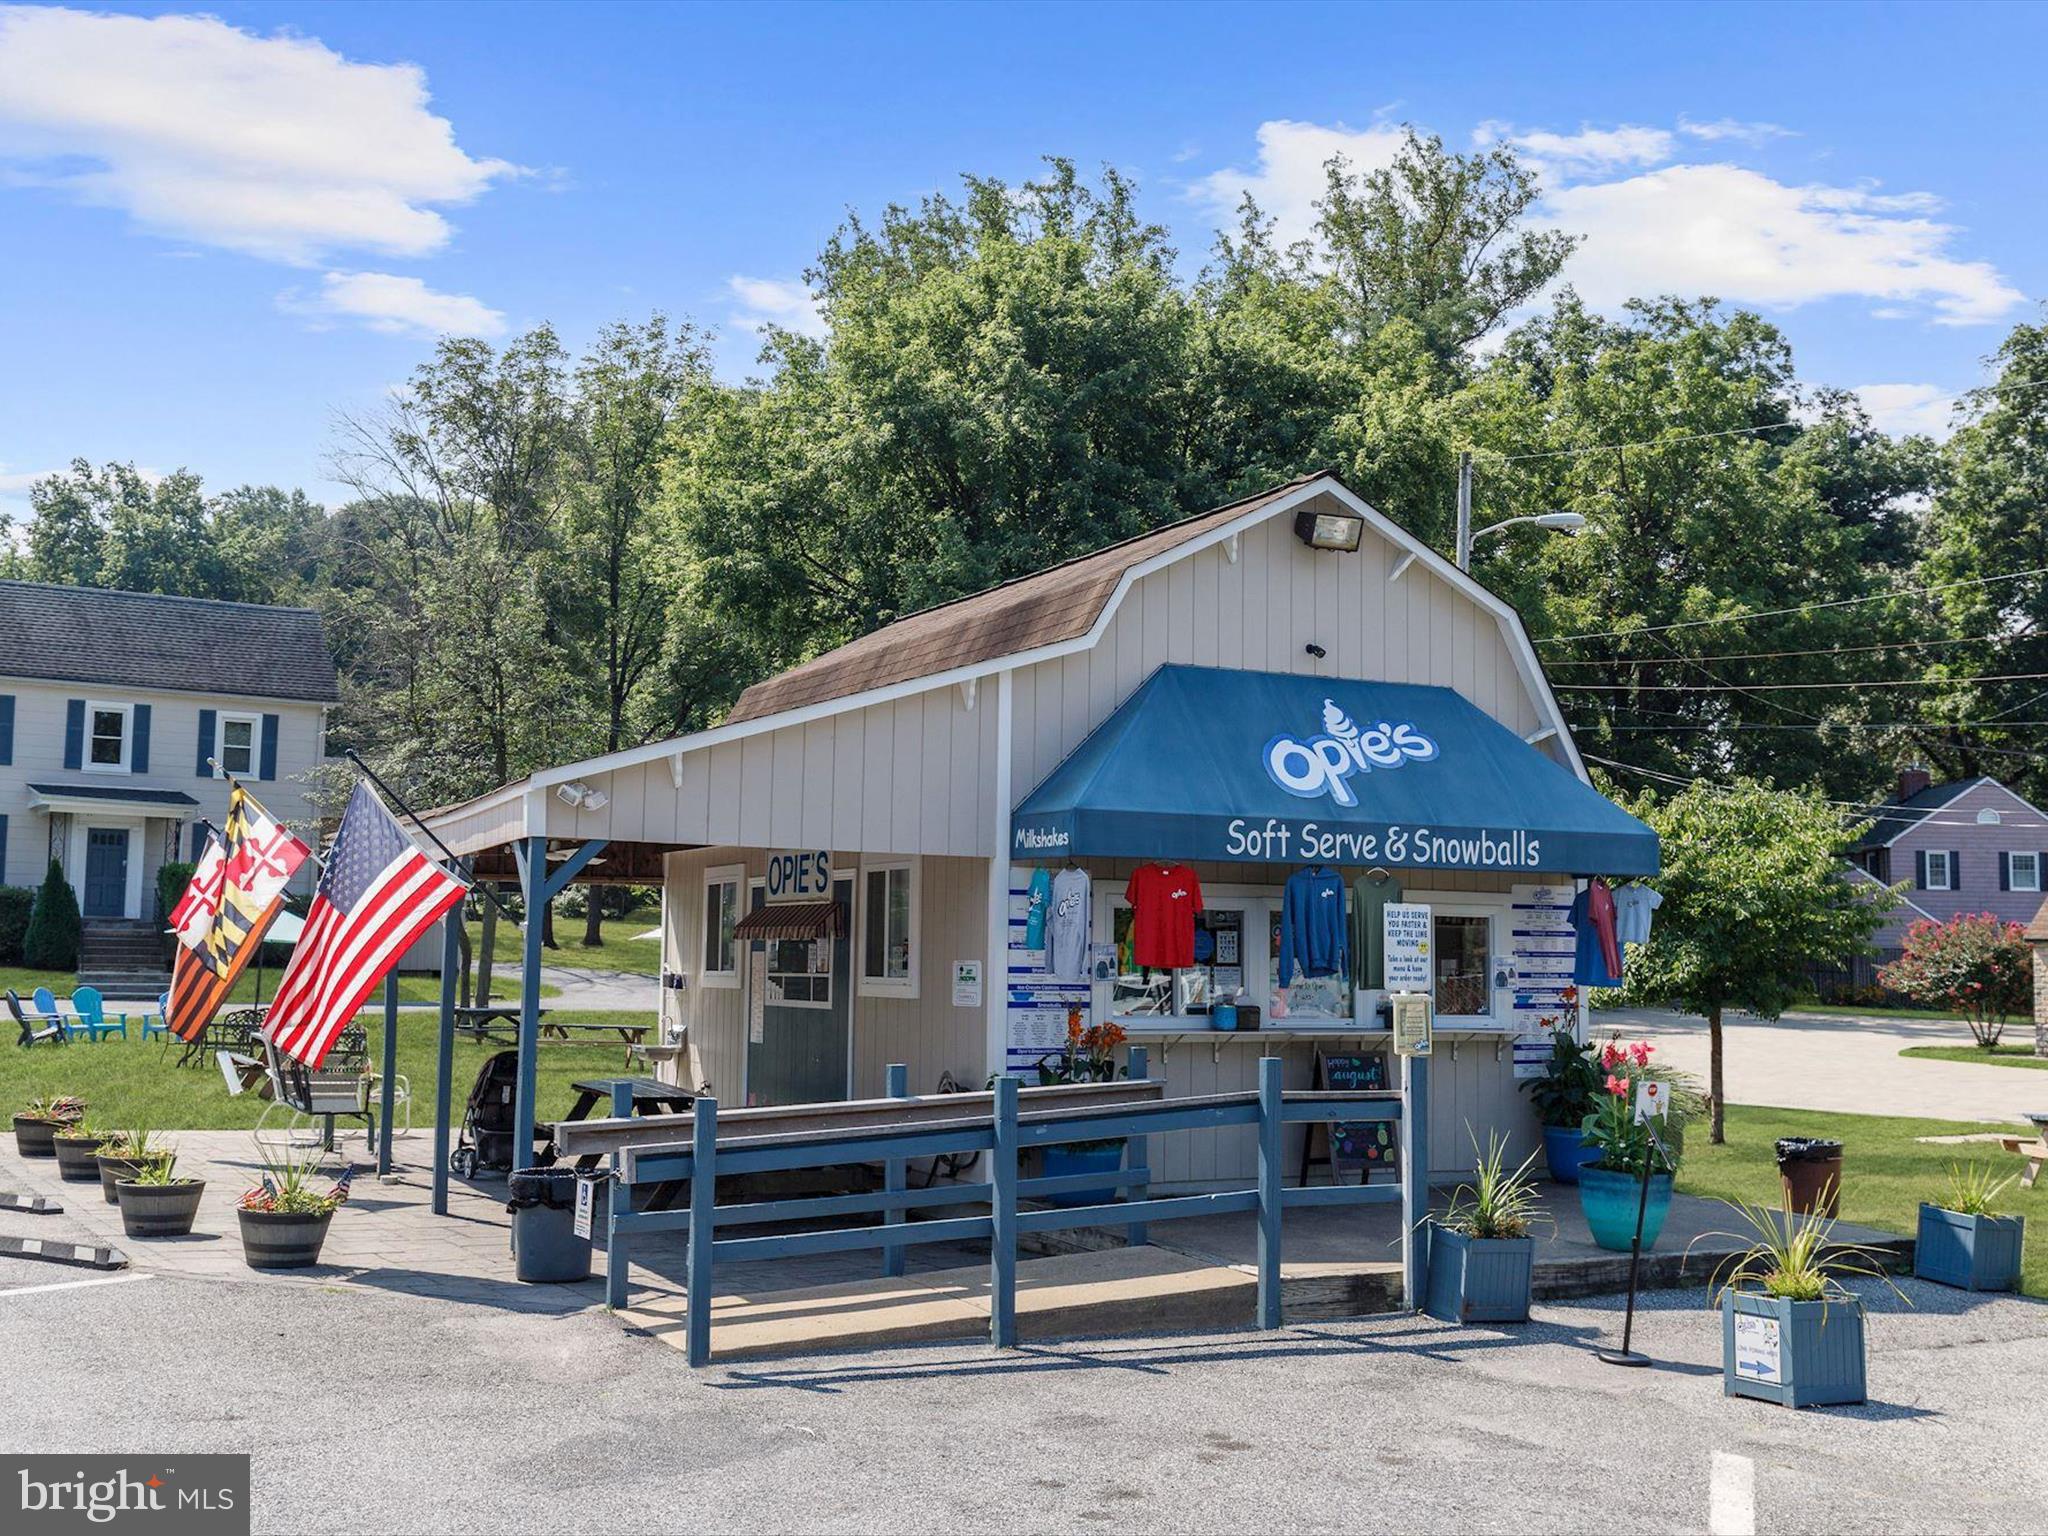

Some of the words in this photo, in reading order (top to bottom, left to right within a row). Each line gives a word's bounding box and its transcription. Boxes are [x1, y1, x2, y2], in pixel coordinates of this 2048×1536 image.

[1265, 699, 1437, 805] Opie's
[1015, 826, 1069, 849] Milkshakes
[1226, 819, 1291, 859] Soft
[1300, 823, 1378, 860] Serve
[1384, 826, 1408, 862] &
[1412, 828, 1540, 866] Snowballs
[769, 851, 828, 895] OPIE'S
[1386, 910, 1400, 918] HELP
[1411, 911, 1428, 920] SERVE
[1403, 930, 1413, 938] THE
[1415, 930, 1428, 938] LINE
[1388, 954, 1398, 962] Take
